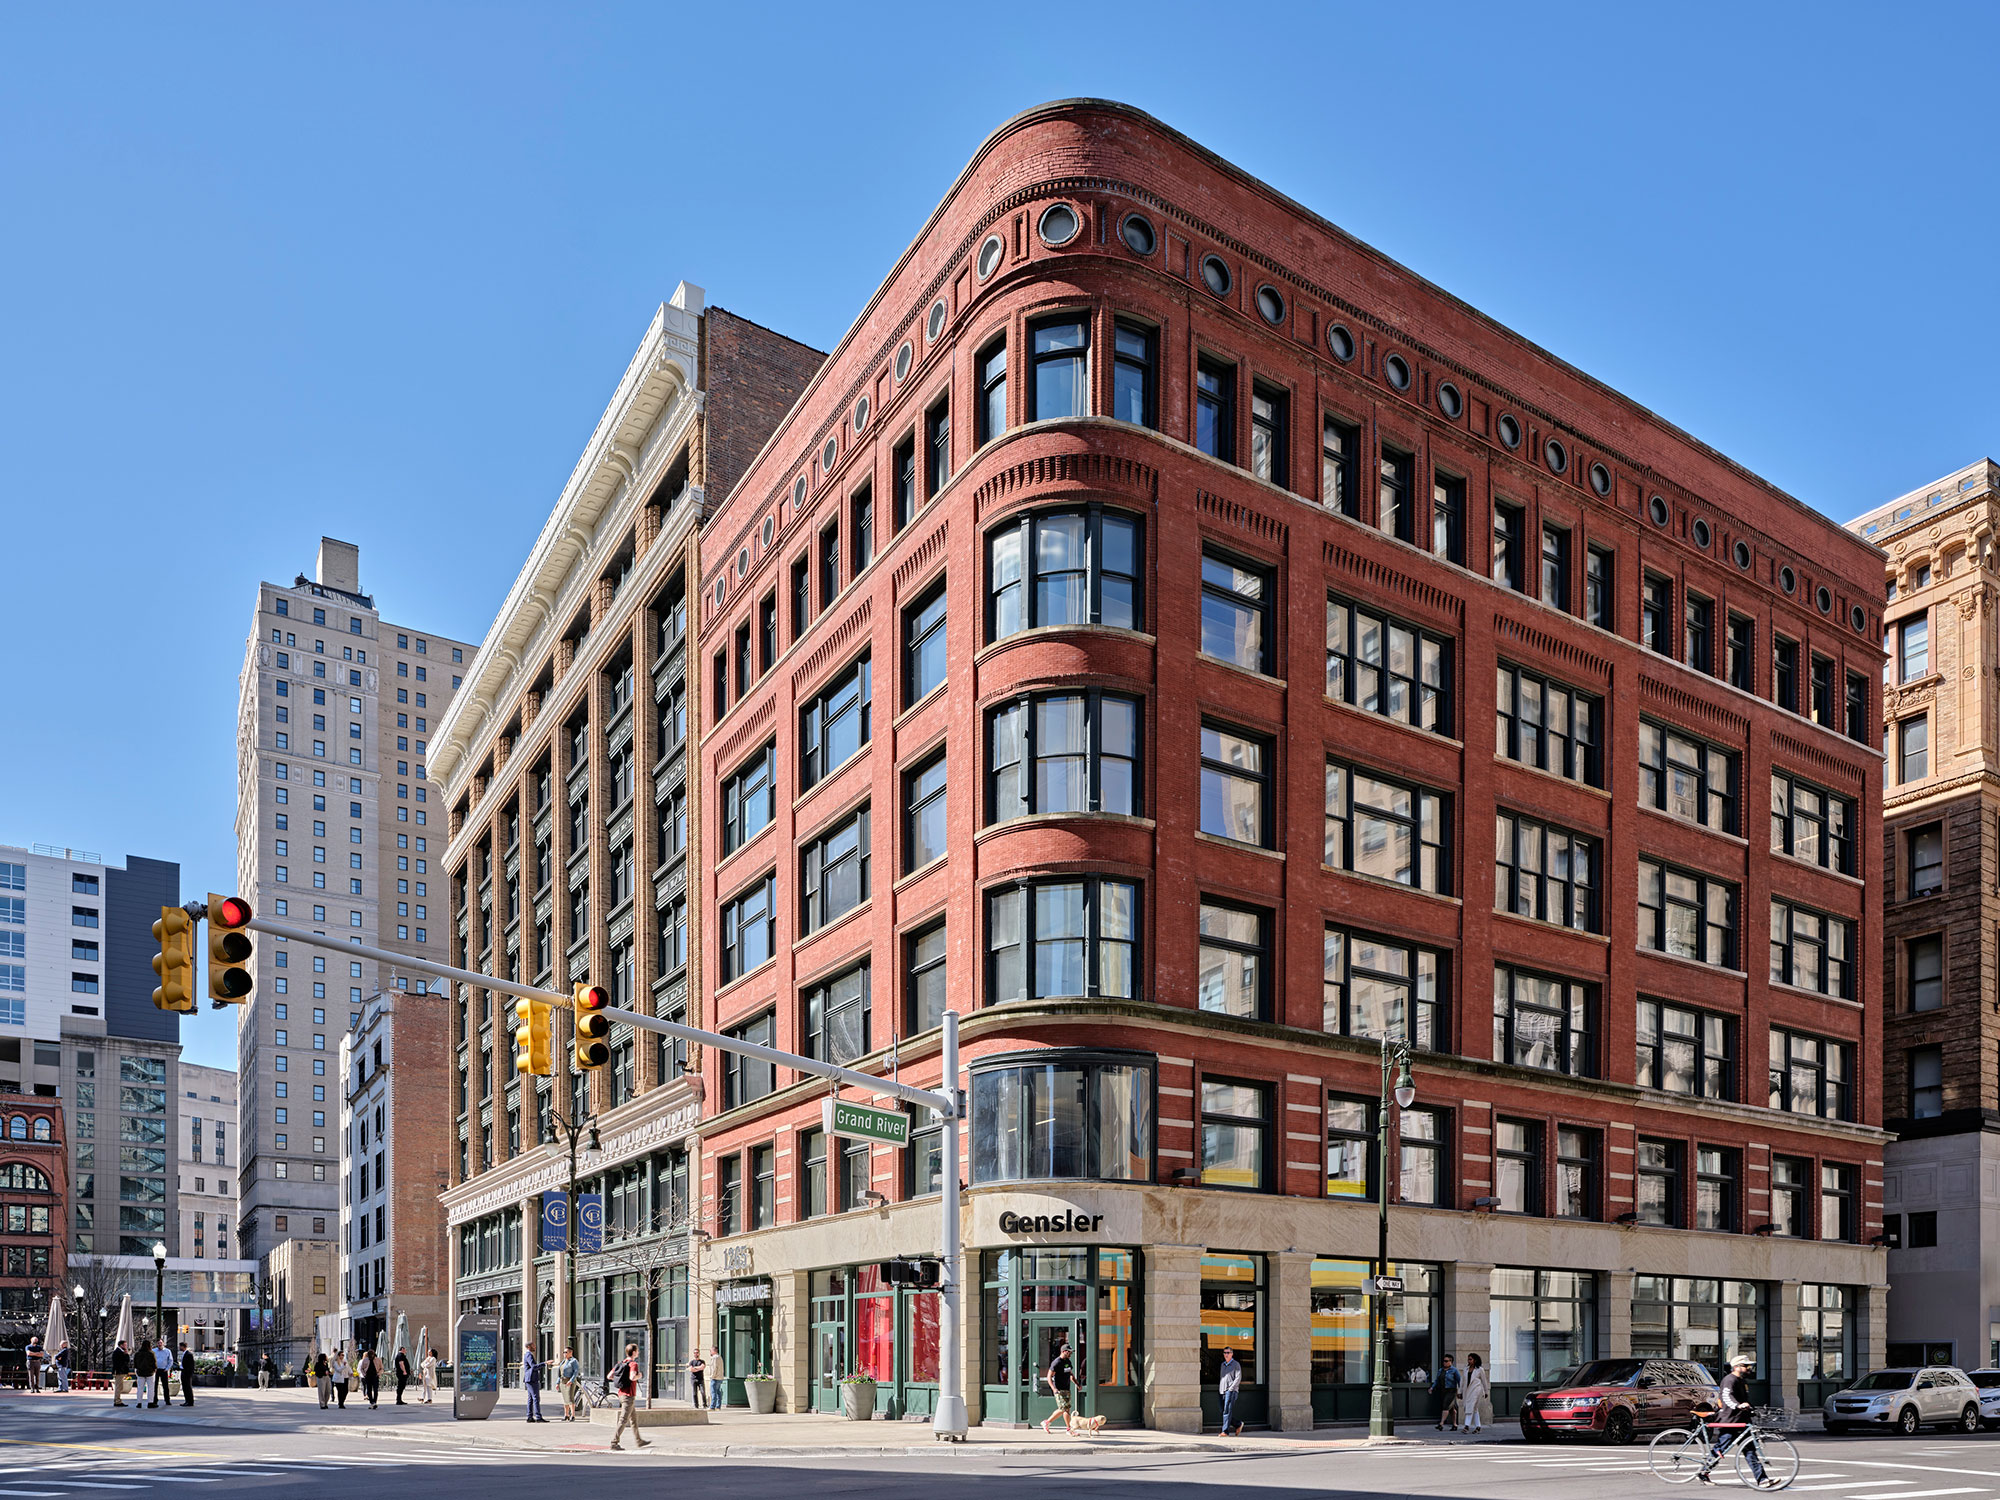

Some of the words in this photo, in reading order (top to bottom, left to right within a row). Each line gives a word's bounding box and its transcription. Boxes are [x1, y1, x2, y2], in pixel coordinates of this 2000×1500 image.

[837, 1109, 872, 1130] Grand
[877, 1117, 905, 1136] River
[999, 1209, 1103, 1234] Gensler
[723, 1245, 747, 1270] 1265
[716, 1288, 731, 1303] MAIN
[732, 1284, 769, 1302] ENTRANCE
